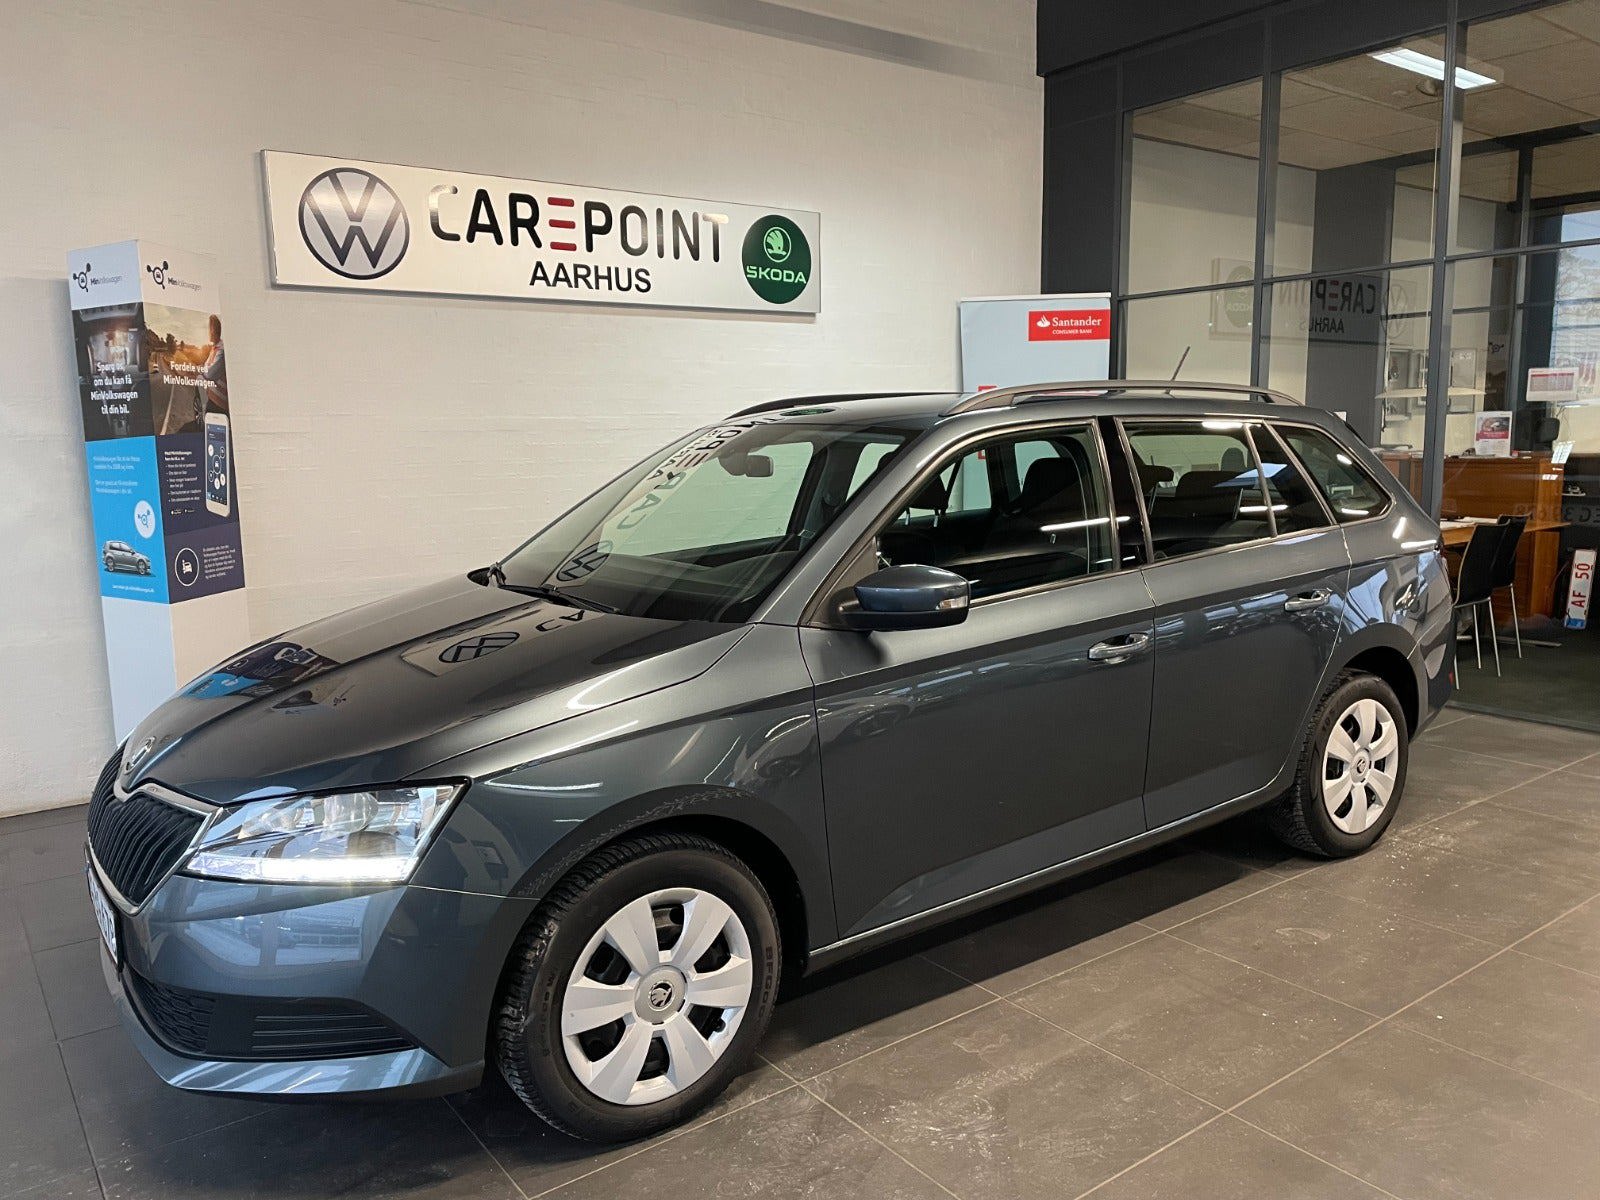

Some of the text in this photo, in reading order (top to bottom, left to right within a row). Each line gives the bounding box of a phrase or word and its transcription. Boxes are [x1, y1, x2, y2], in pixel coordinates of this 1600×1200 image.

[428, 184, 730, 263] CAREPOINT
[529, 260, 652, 293] AARHUS
[1052, 315, 1102, 327] Santander
[170, 360, 196, 373] Fordele
[93, 378, 104, 387] om
[104, 375, 113, 386] du
[90, 390, 139, 402] MinVolkswagen
